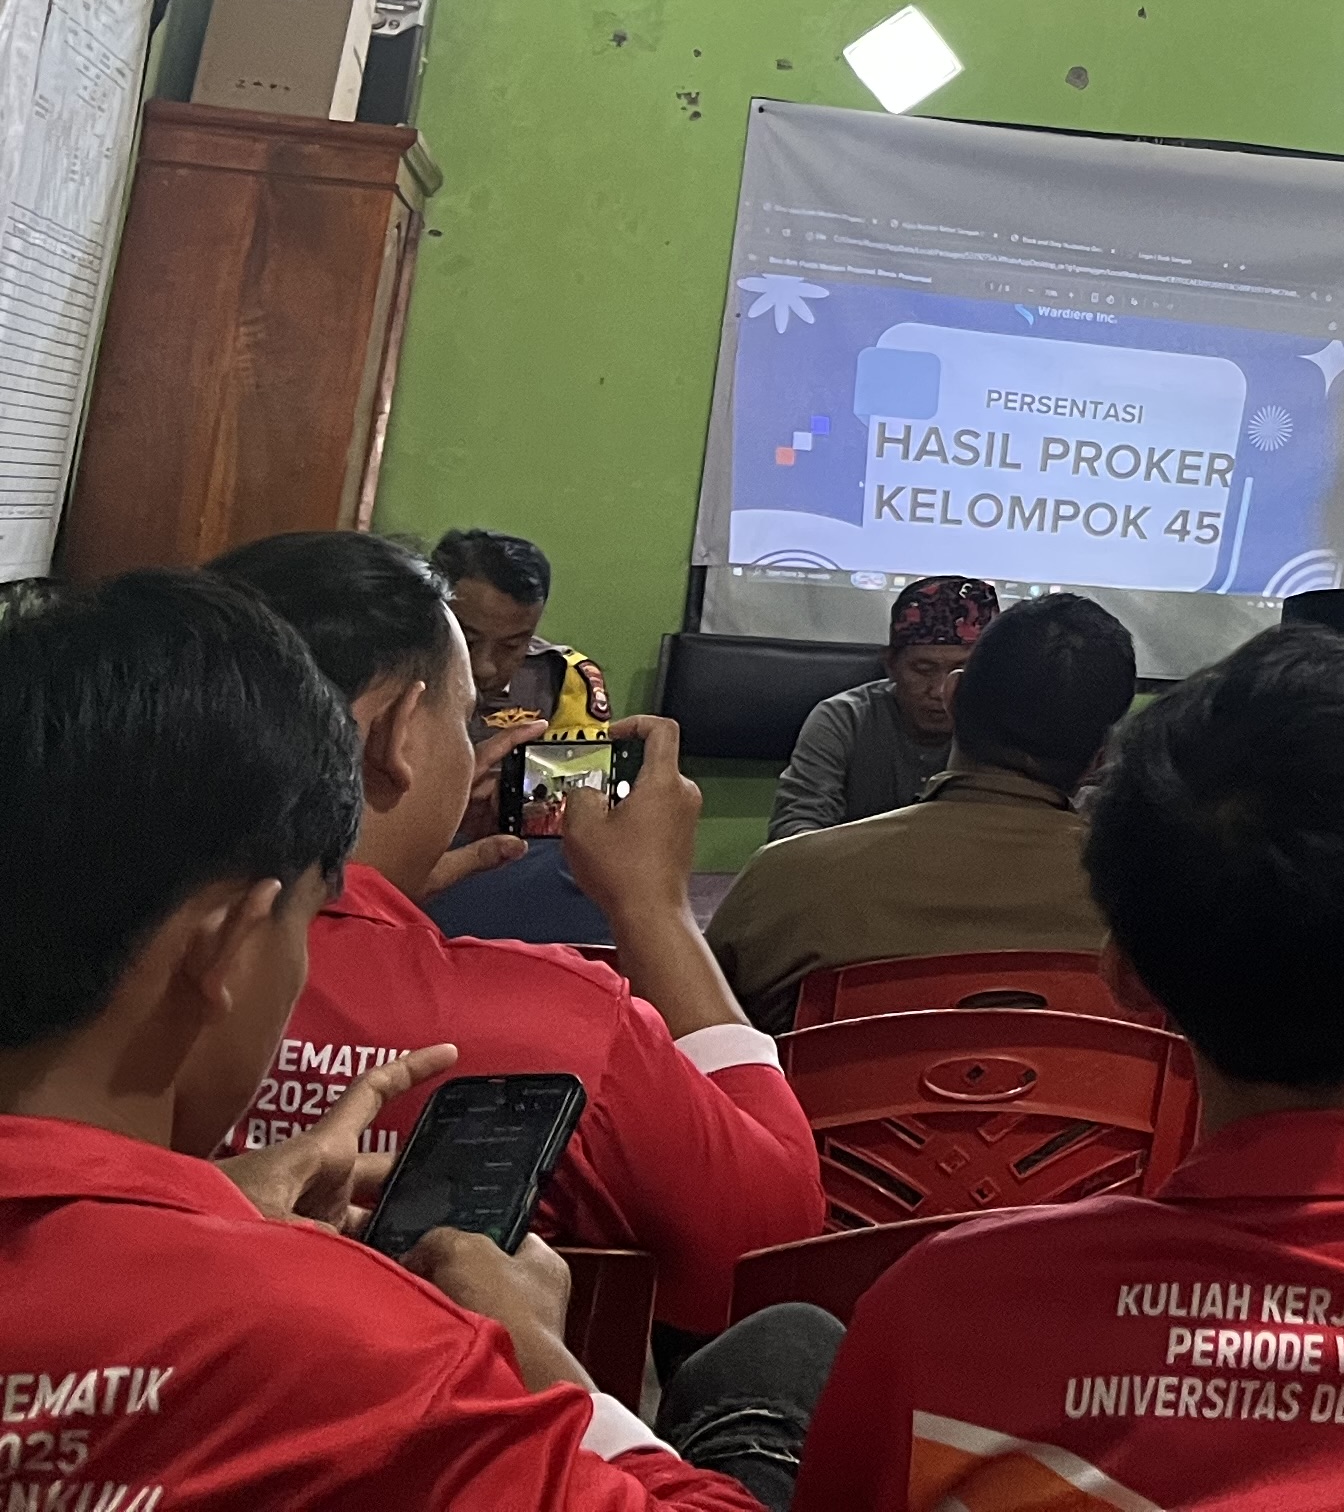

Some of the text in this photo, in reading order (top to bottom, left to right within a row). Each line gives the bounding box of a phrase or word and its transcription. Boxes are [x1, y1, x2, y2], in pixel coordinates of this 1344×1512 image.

[1097, 311, 1119, 325] Inc.
[985, 389, 1144, 424] PERSENTASI
[875, 421, 1235, 488] HASIL PROKER
[874, 484, 1222, 545] KELOMPOK 45
[1116, 1282, 1251, 1317] KULIAH
[1165, 1326, 1323, 1372] PERIODE
[1064, 1376, 1301, 1422] UNIVERSITAS
